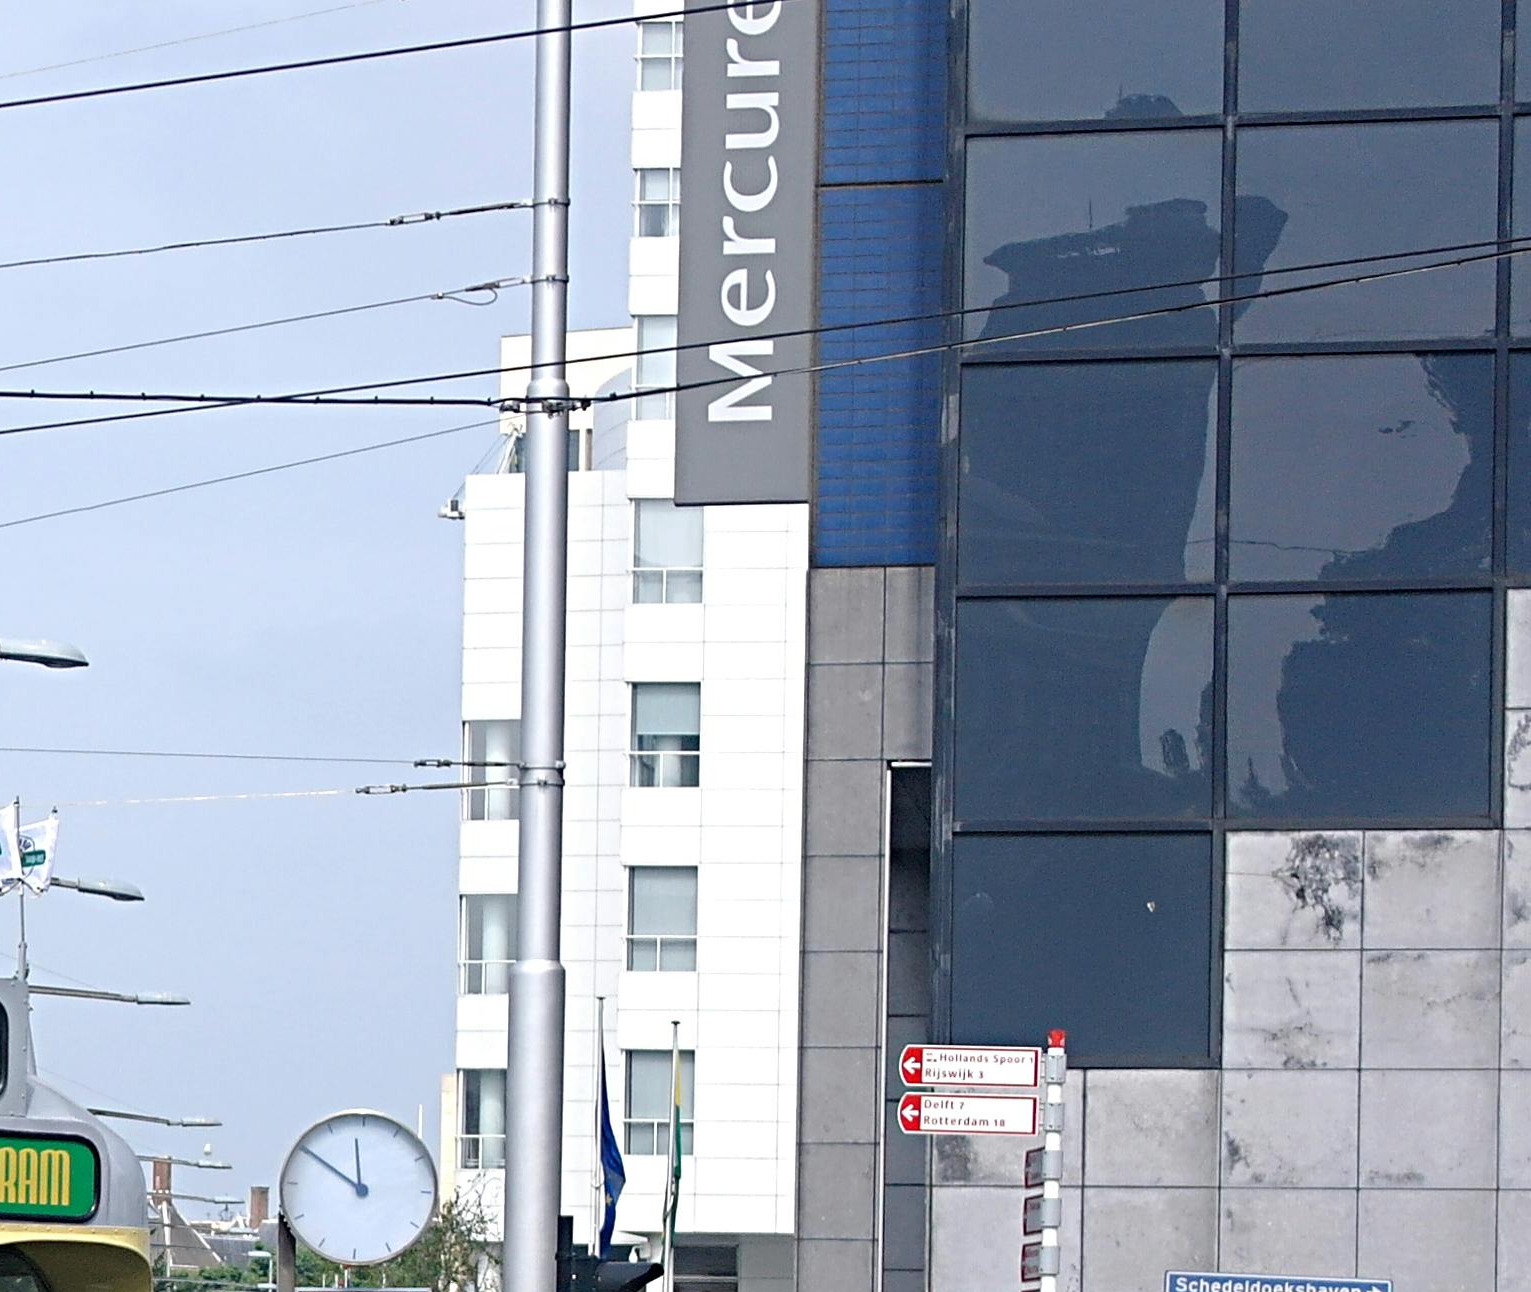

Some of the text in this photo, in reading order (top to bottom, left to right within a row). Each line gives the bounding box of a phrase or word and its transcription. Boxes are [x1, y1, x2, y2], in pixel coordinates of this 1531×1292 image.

[707, 0, 782, 422] Mercure
[939, 1053, 989, 1064] Hollands
[993, 1054, 1025, 1066] Spoor
[925, 1068, 984, 1081] Rijswijk 3
[924, 1099, 965, 1110] Delft 7
[923, 1116, 1006, 1127] Rotterdam 18
